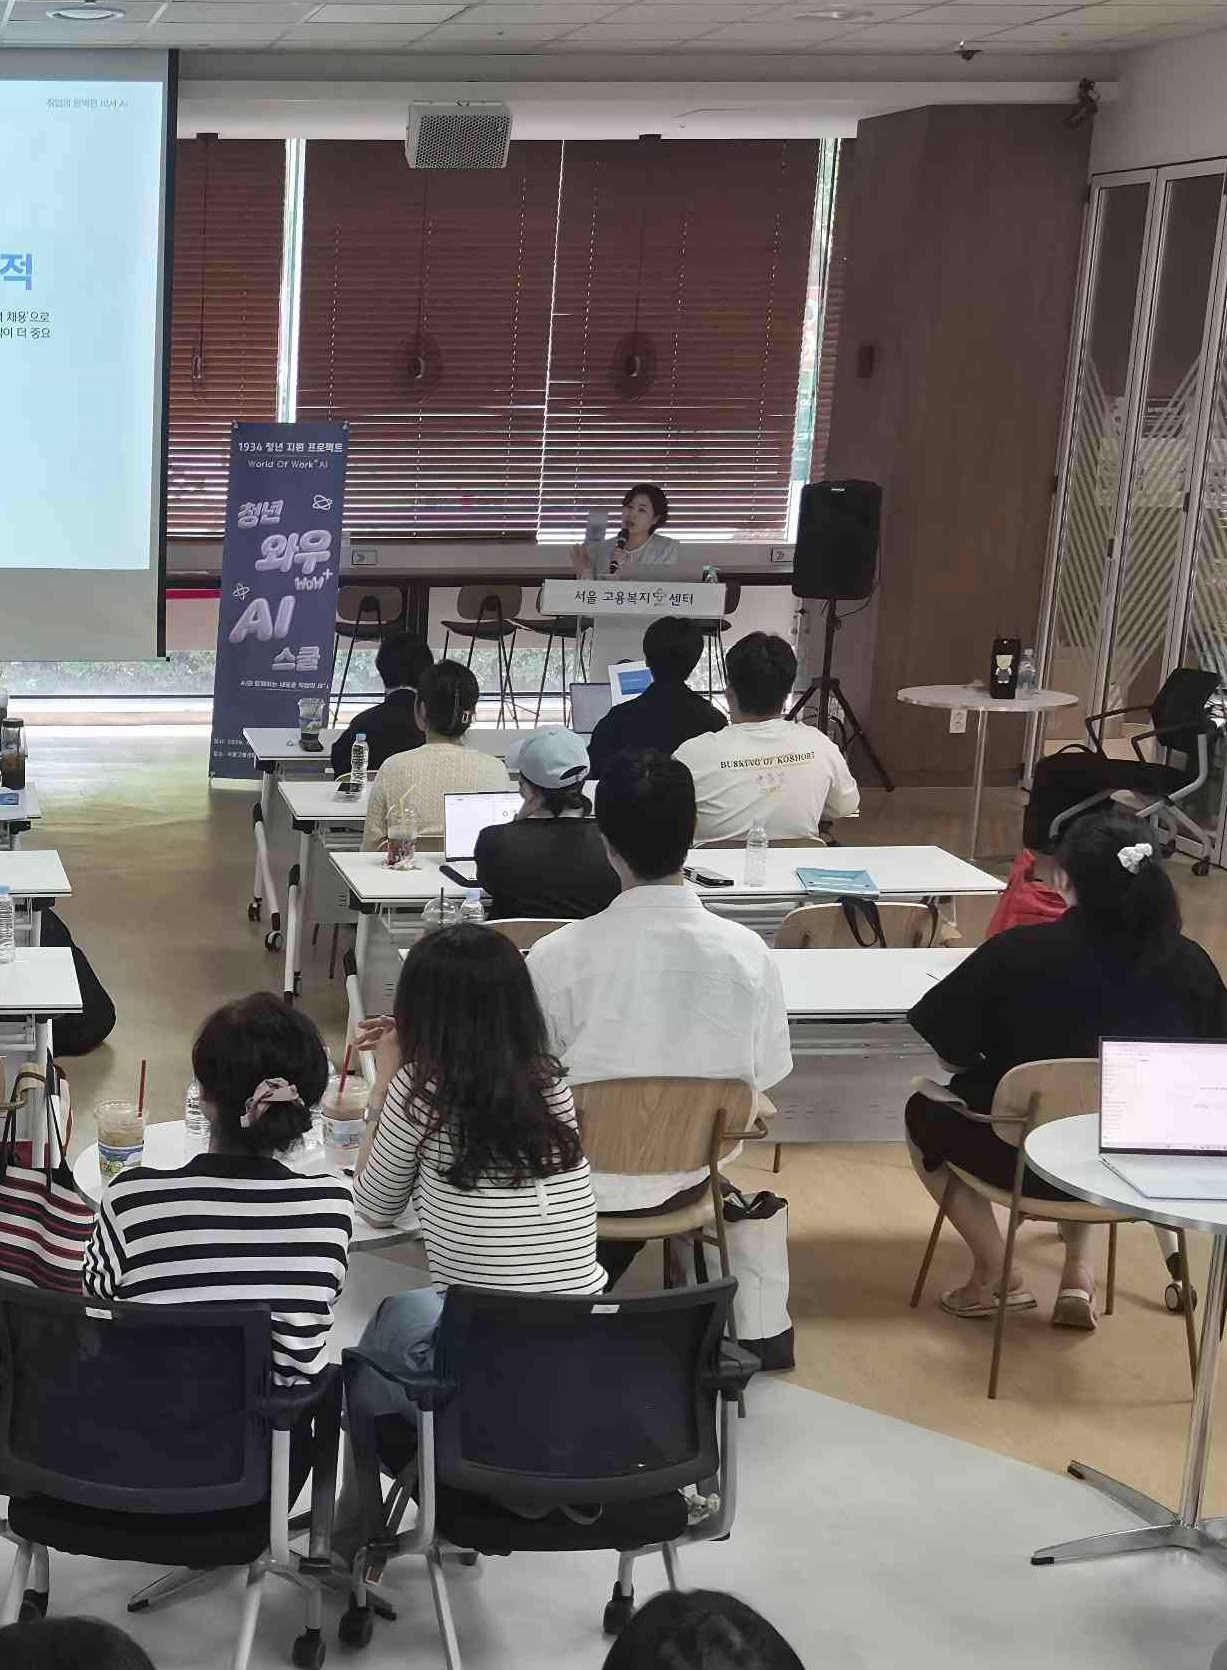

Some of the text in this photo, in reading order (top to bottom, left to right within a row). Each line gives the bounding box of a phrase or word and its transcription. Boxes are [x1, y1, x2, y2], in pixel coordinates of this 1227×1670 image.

[17, 327, 27, 339] 더
[31, 327, 51, 339] 중요
[238, 442, 343, 453] 1934 청년 지원 프로젝트
[248, 460, 273, 468] World
[276, 460, 288, 468] Of
[319, 460, 328, 468] AI
[238, 500, 284, 529] 청년
[255, 530, 332, 575] 와우
[574, 591, 694, 607] 서울 고용복지 센터
[229, 595, 296, 643] AI
[271, 646, 321, 672] 스쿨
